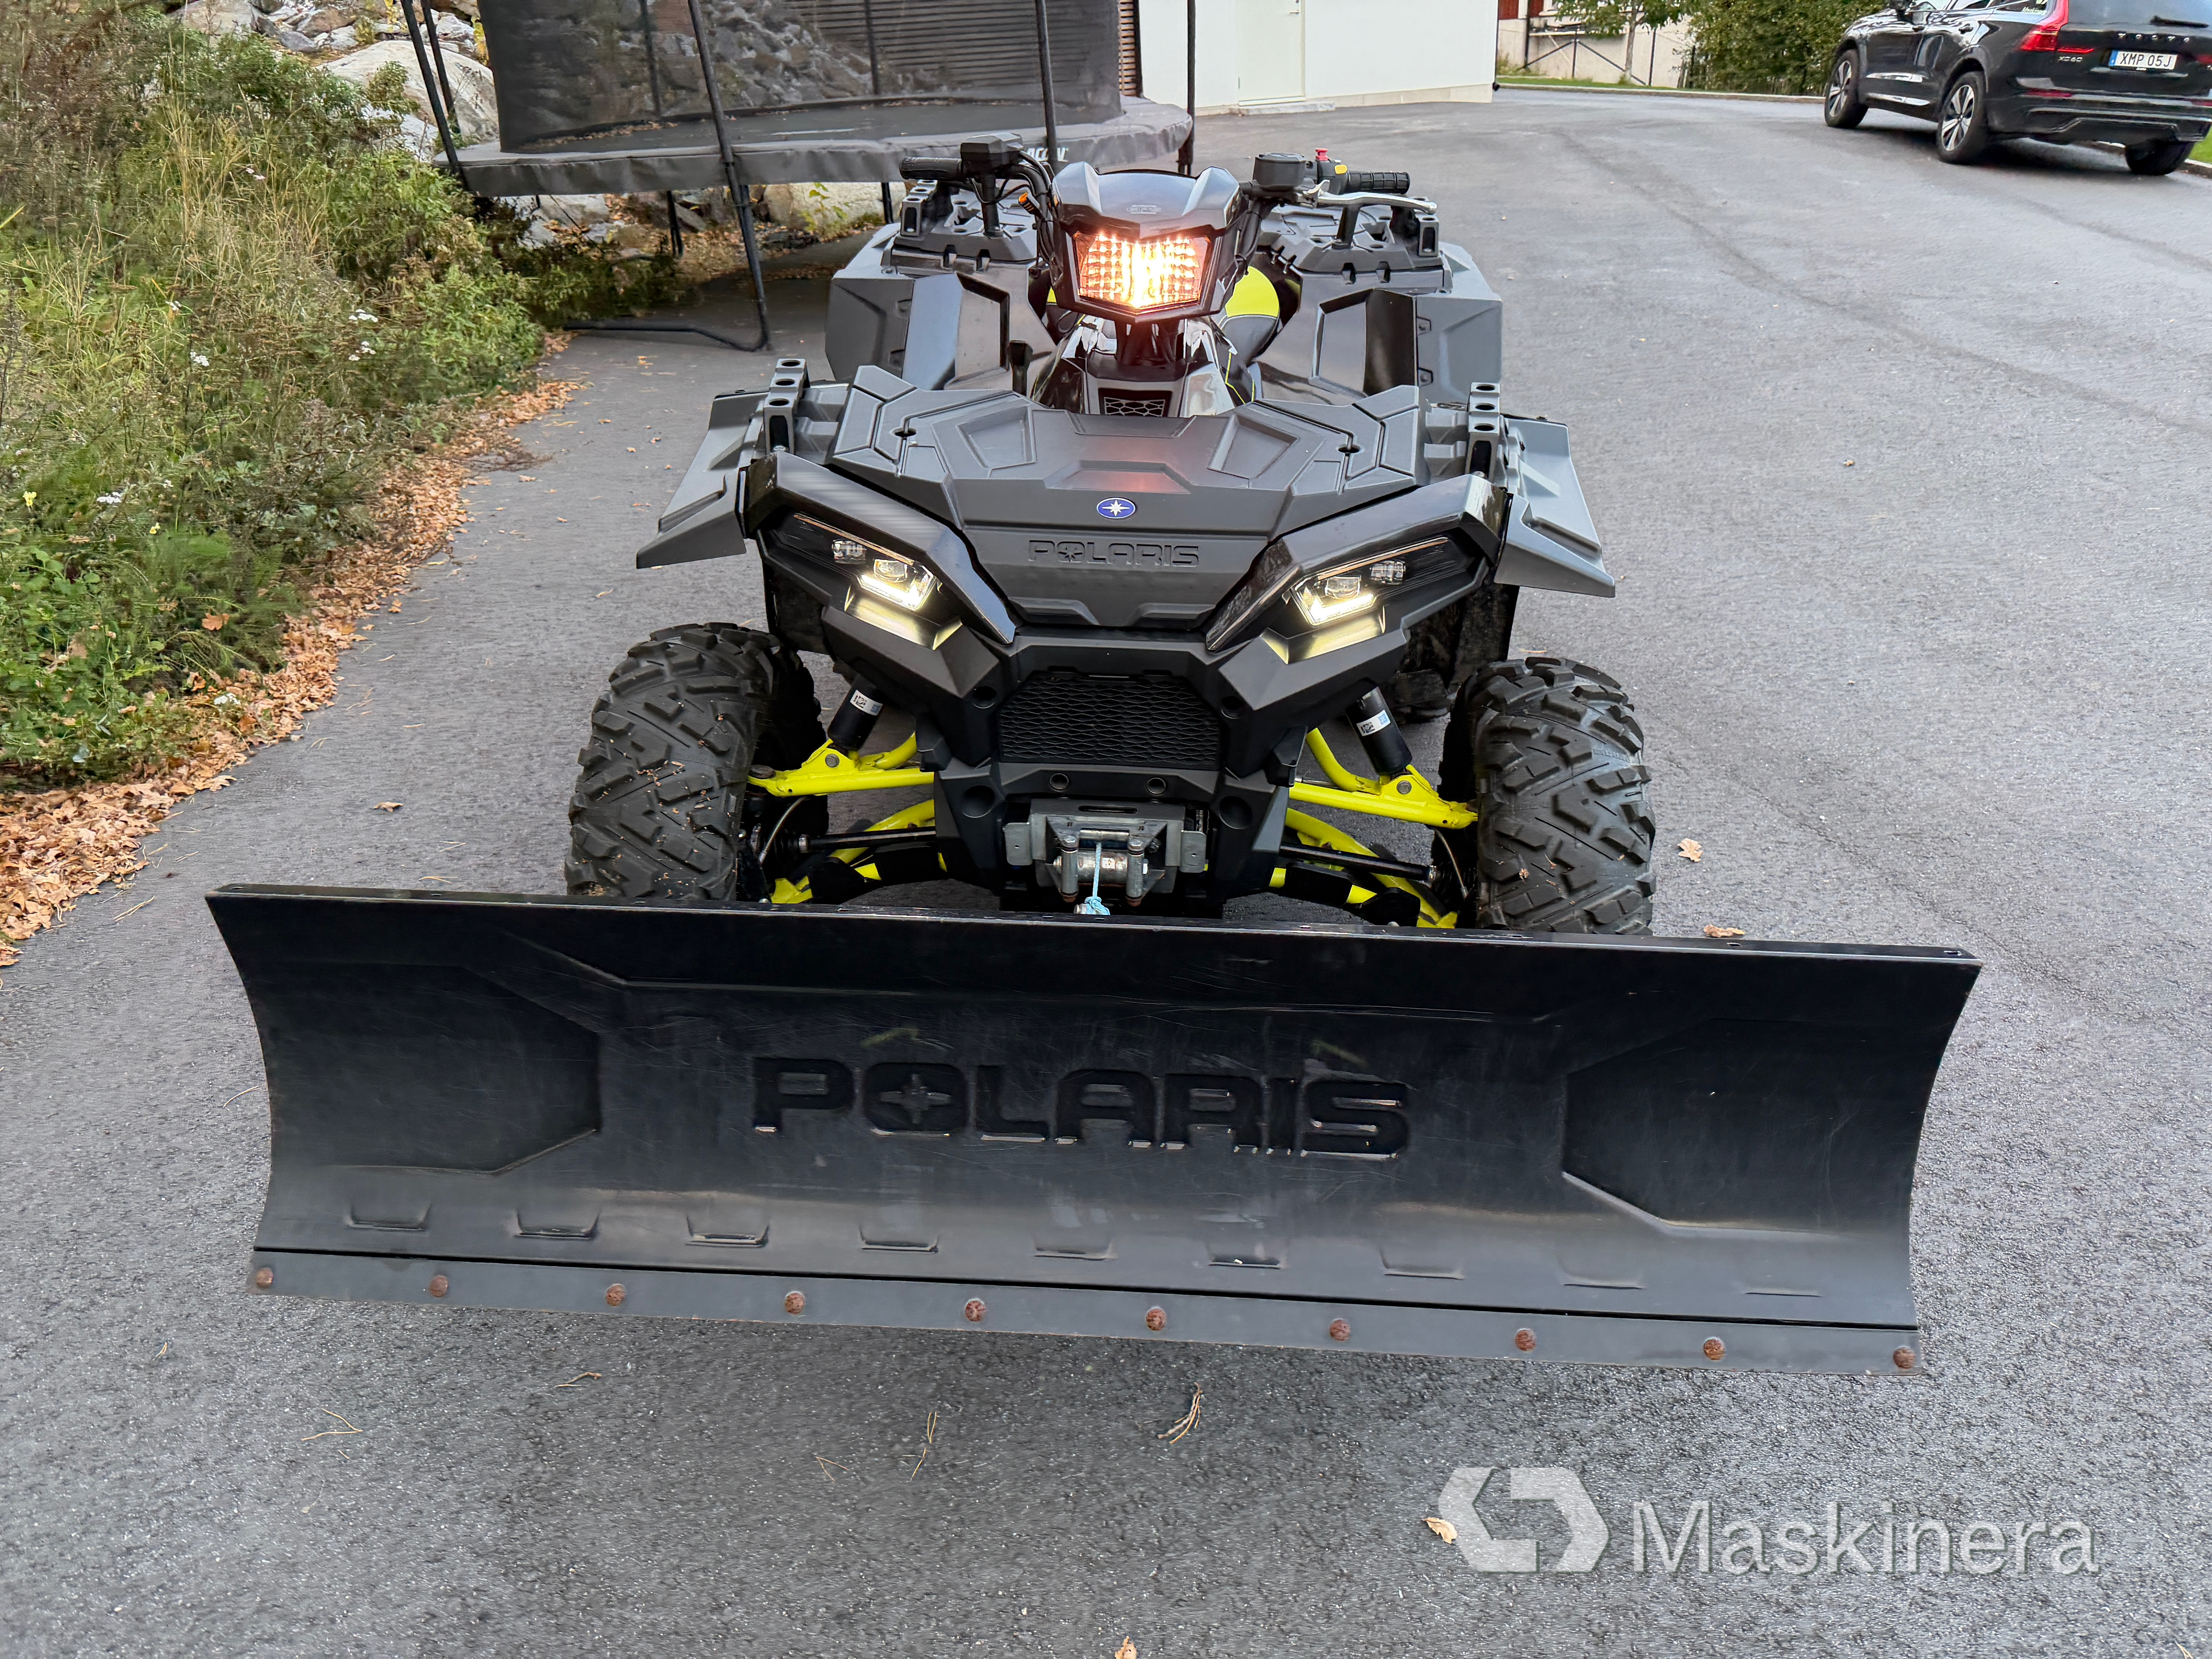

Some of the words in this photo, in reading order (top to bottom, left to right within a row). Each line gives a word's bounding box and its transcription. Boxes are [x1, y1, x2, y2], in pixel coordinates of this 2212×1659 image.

[2118, 33, 2190, 42] VOLVO
[2120, 53, 2145, 65] XMP
[2147, 55, 2172, 67] 05J
[1028, 539, 1199, 567] POLARIS
[752, 1057, 1411, 1162] POLARIS
